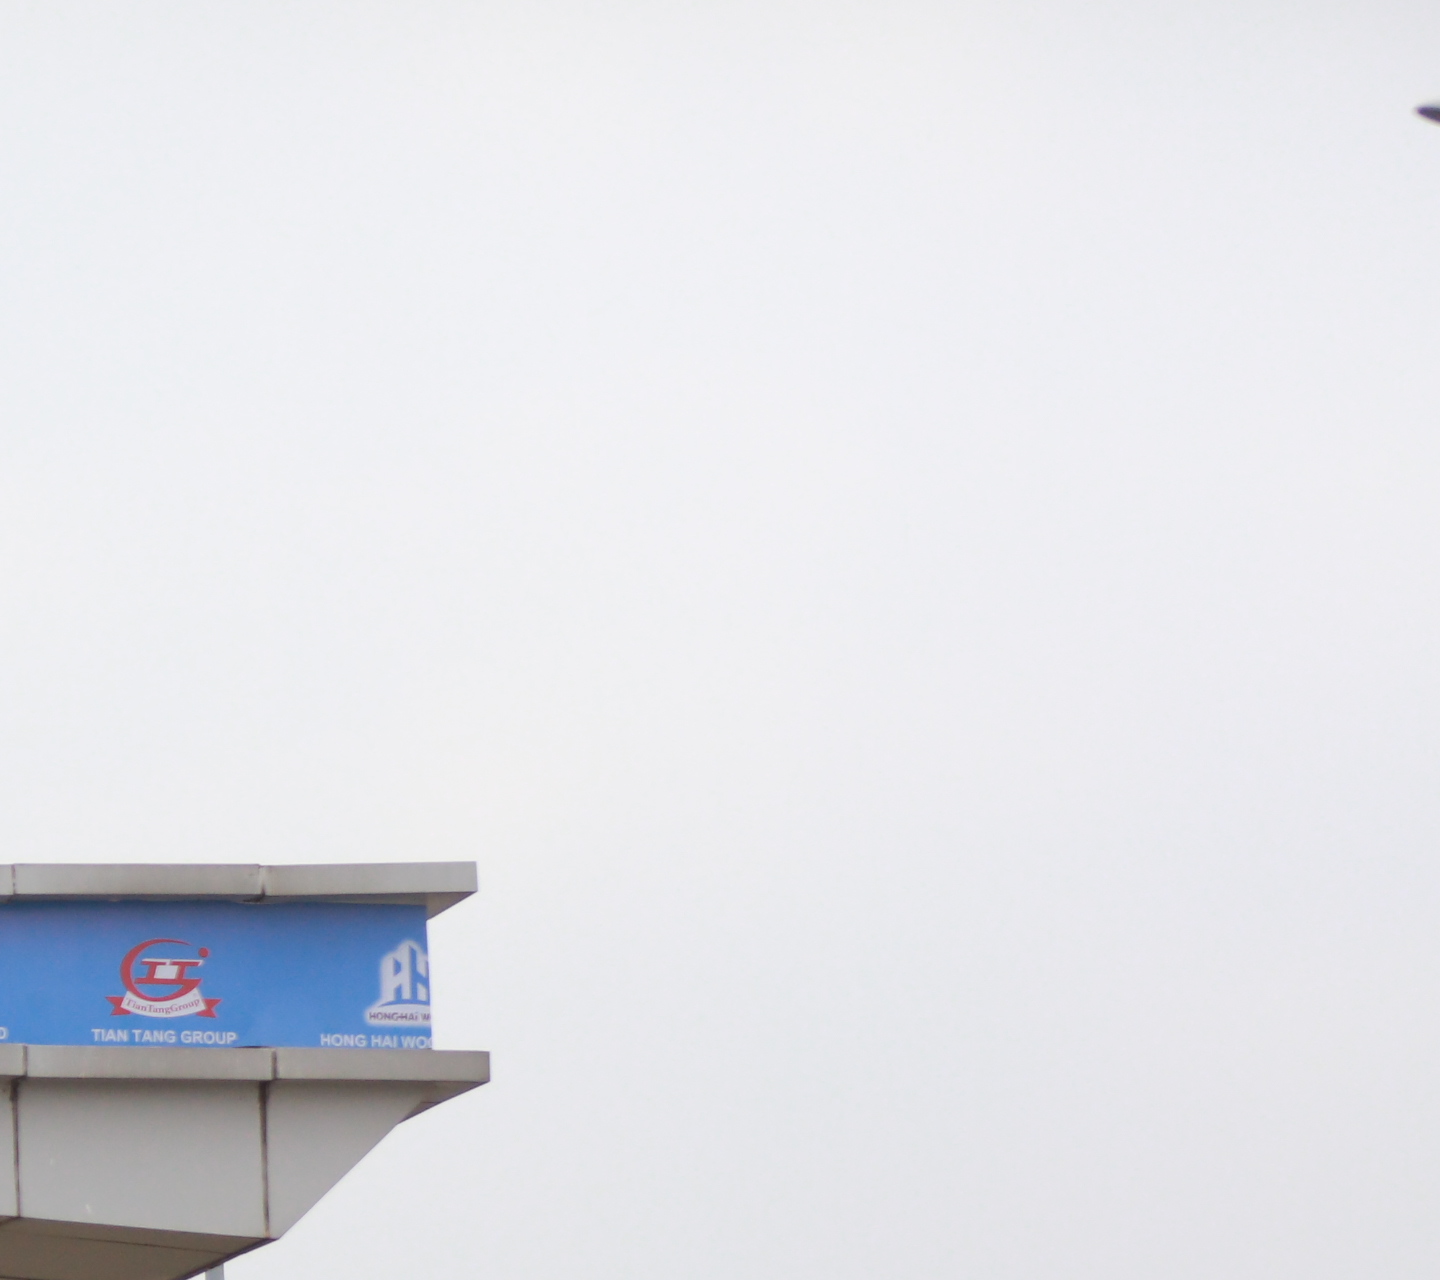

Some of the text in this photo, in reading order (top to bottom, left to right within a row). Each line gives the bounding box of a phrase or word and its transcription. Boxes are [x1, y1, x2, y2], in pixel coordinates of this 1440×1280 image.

[91, 1028, 237, 1044] TIAN TANG GROUP
[319, 1034, 368, 1047] HONG
[371, 1035, 395, 1047] HAI
